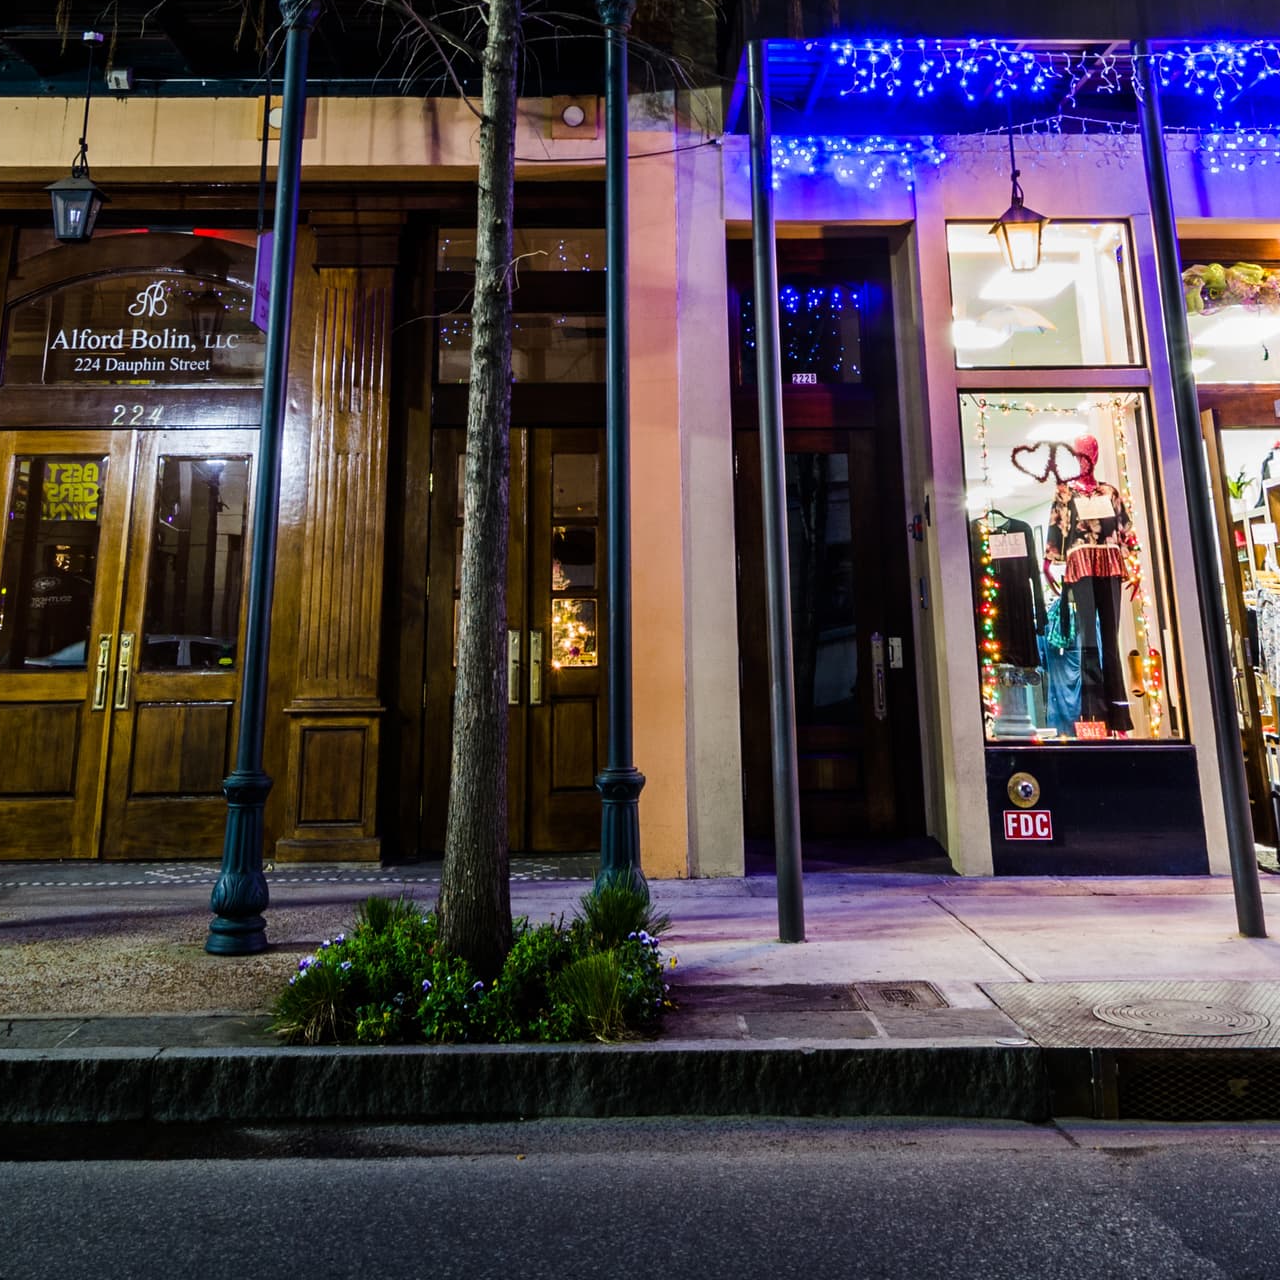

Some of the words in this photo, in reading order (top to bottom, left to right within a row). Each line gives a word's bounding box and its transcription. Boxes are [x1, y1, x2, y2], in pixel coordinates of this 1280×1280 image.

[50, 328, 124, 350] Alford
[130, 328, 197, 352] Bolin,
[204, 334, 240, 349] LLC
[74, 358, 101, 372] 224
[105, 358, 165, 375] Dauphin
[170, 357, 210, 371] Street
[111, 405, 164, 426] 224
[1082, 728, 1100, 737] SALE
[1007, 814, 1049, 836] FDC
